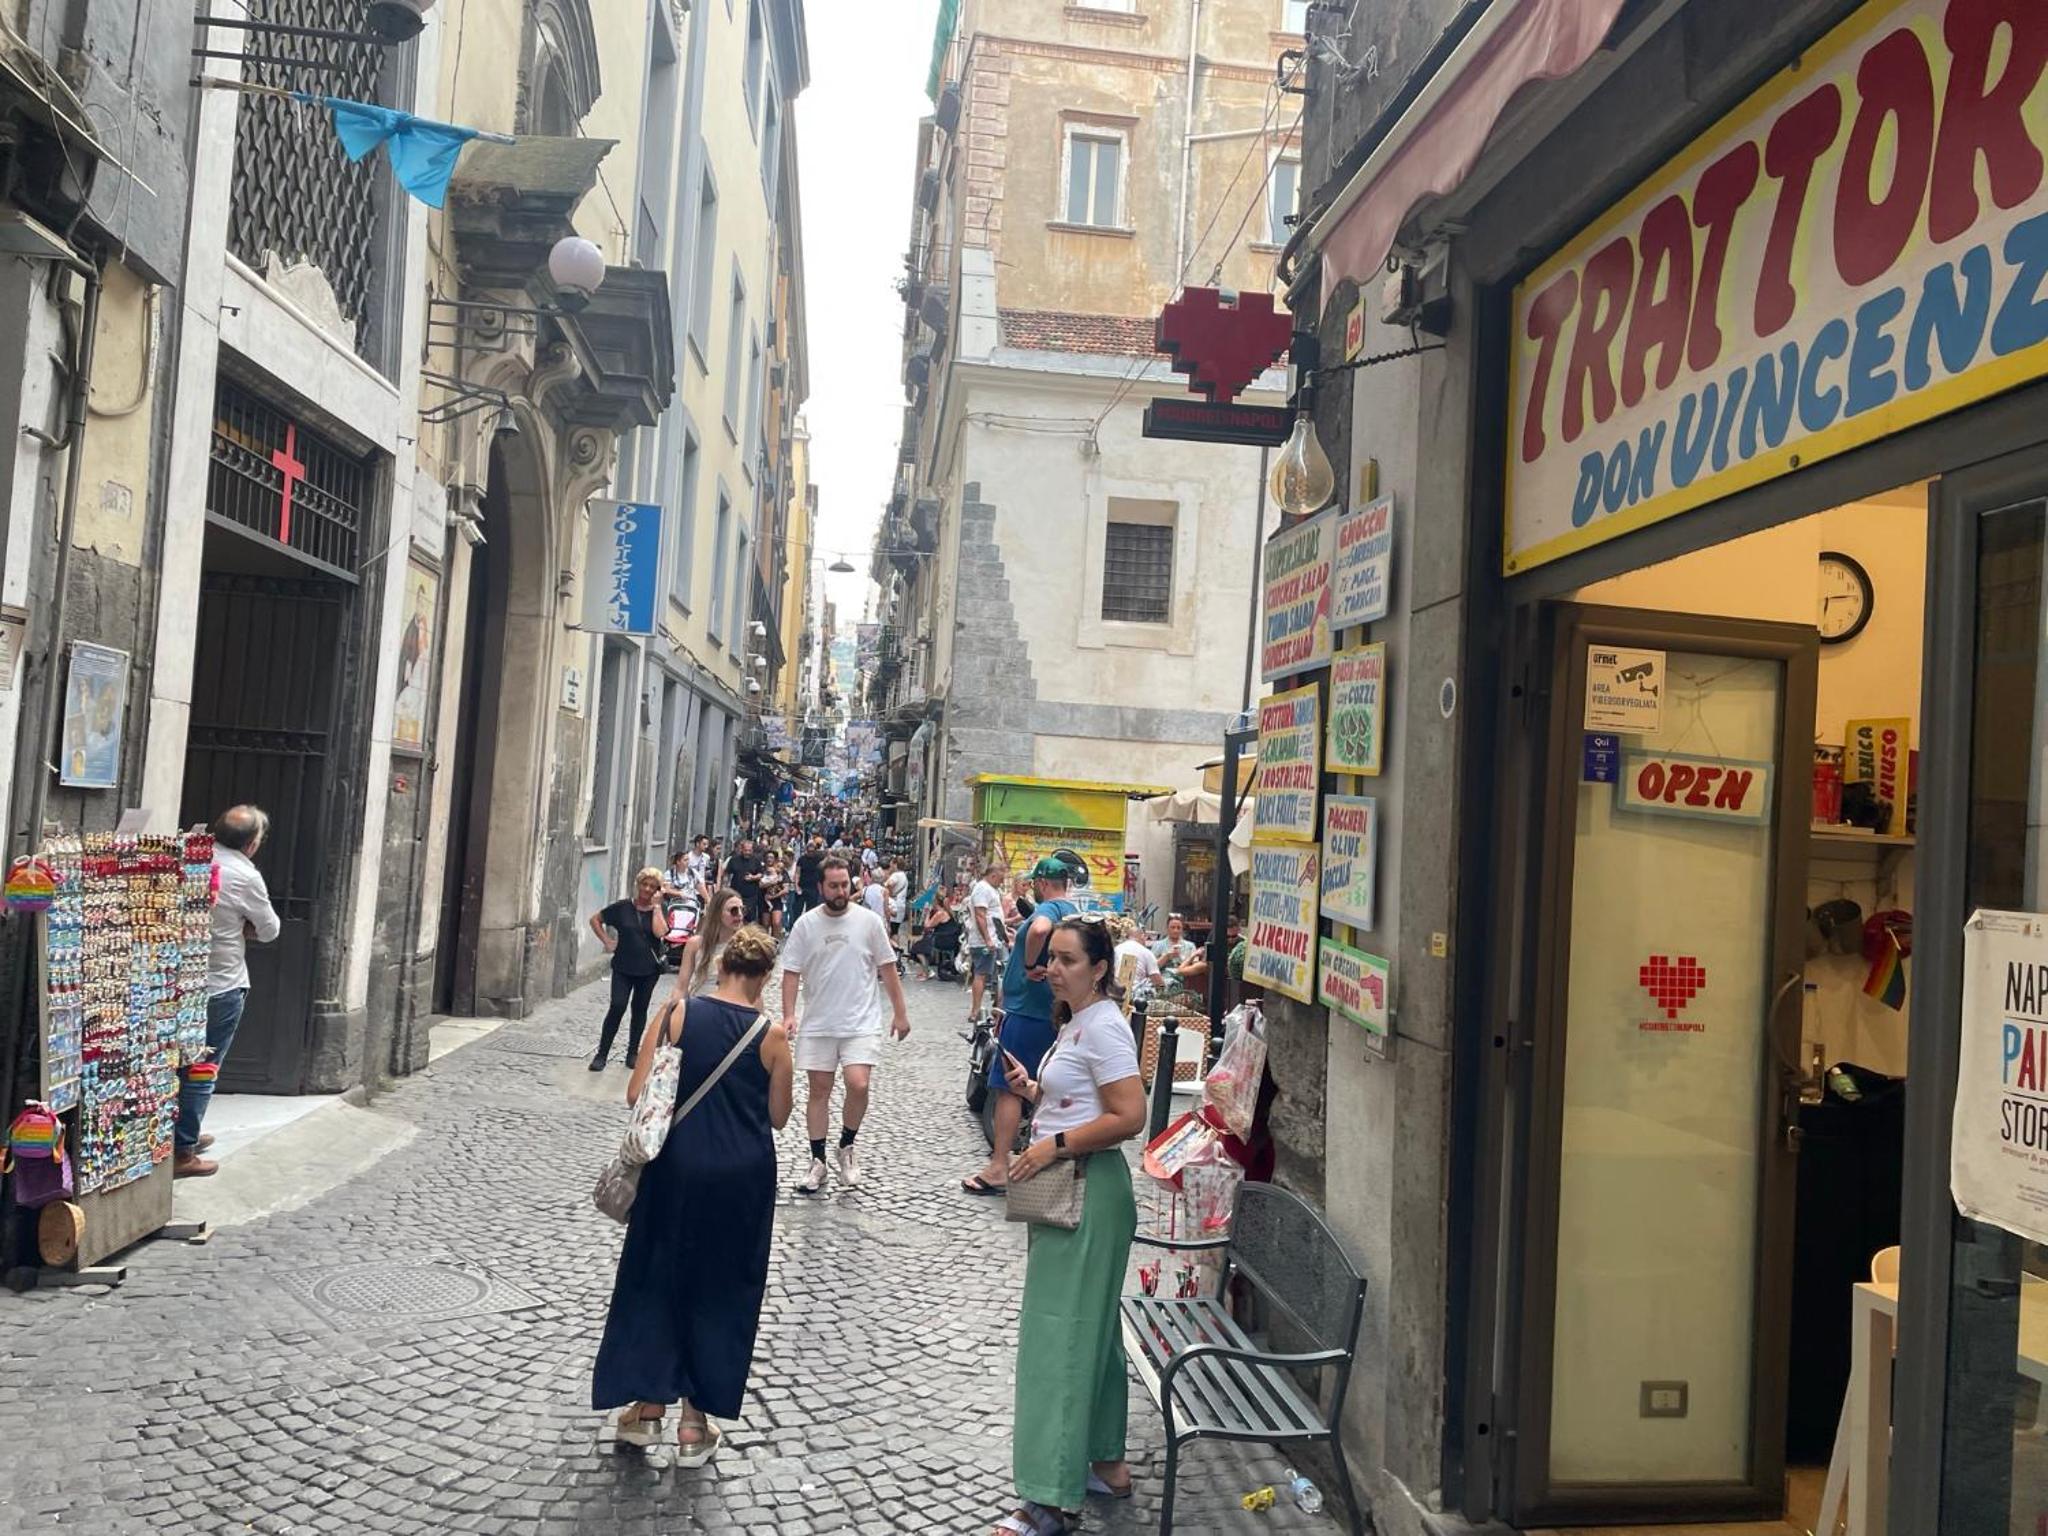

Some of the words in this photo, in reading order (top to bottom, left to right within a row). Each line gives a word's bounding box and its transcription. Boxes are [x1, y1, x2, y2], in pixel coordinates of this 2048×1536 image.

[1523, 0, 2048, 462] TRATTOR
[1572, 421, 1666, 527] DON
[1340, 505, 1388, 550] GNOCCHI
[608, 503, 637, 605] POLIZIA
[1300, 562, 1330, 597] SALAD
[1593, 683, 1611, 694] AREA
[1638, 763, 1753, 811] OPEN
[1880, 729, 1897, 801] HIUSO
[1252, 921, 1309, 963] LINGUINE
